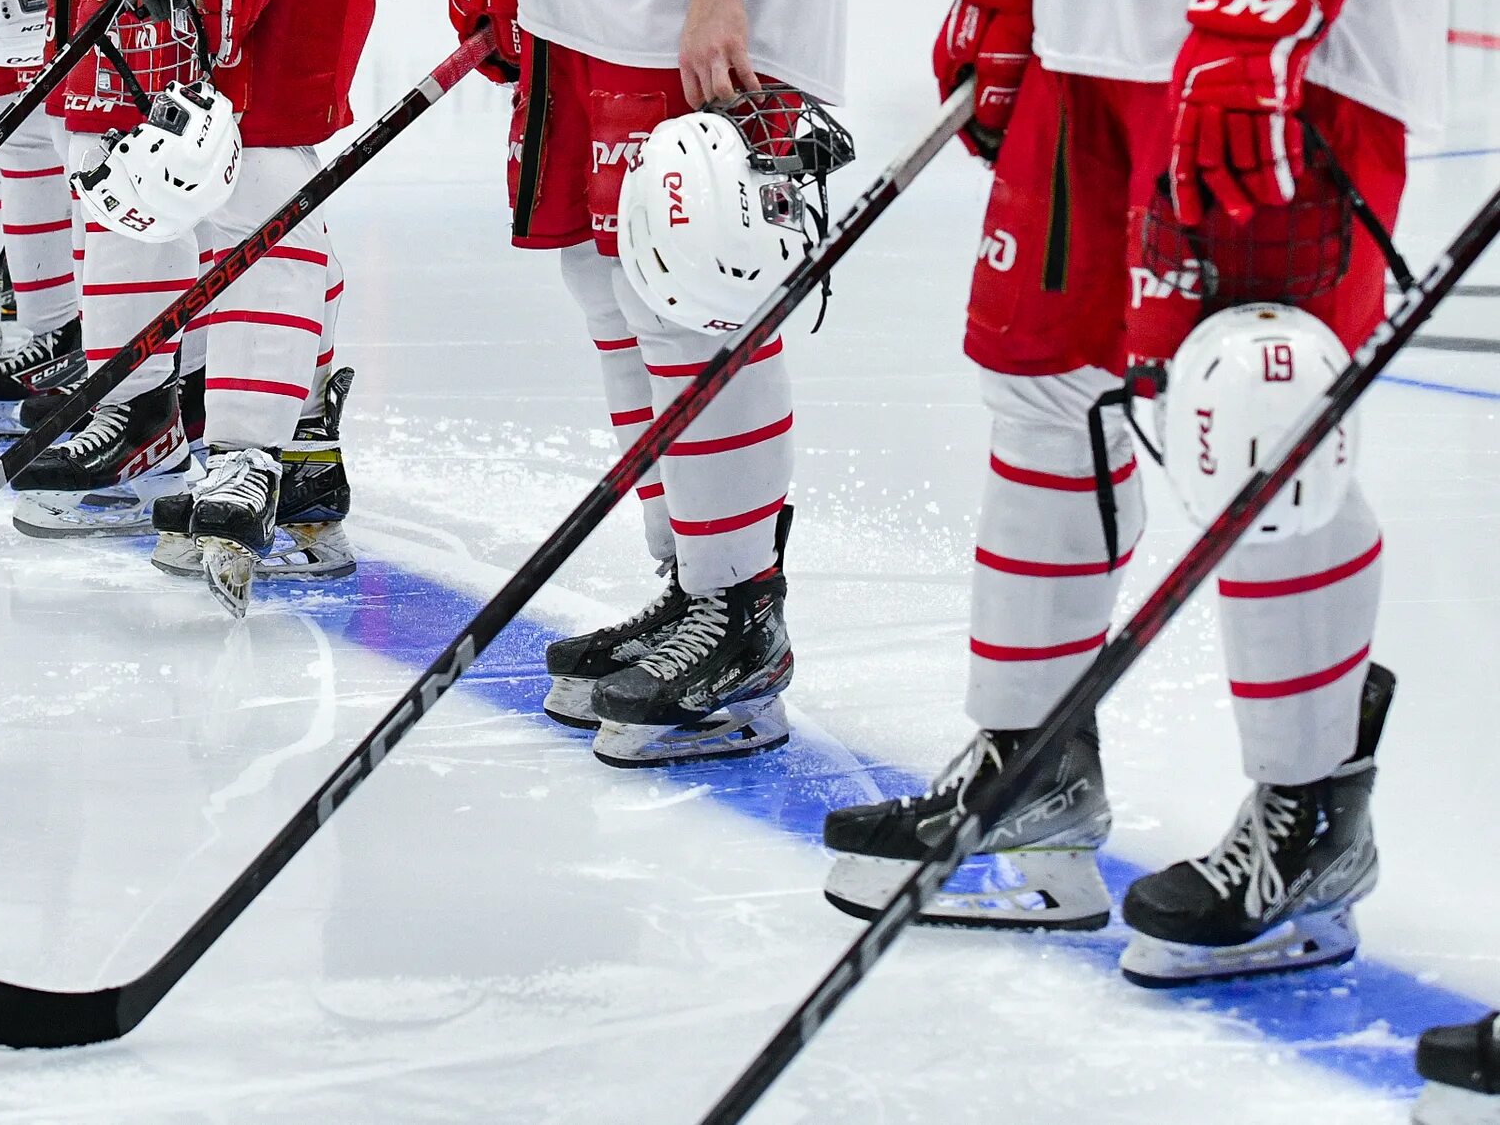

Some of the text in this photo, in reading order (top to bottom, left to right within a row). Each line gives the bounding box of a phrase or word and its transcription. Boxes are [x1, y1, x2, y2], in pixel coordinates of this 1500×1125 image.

[510, 19, 522, 54] CCM
[64, 96, 118, 113] CCM
[737, 180, 750, 229] CCM
[118, 208, 155, 232] 33
[591, 214, 618, 233] CC
[128, 217, 286, 371] JETSPEED
[30, 359, 69, 384] CCM
[116, 421, 186, 483] CCM
[711, 667, 742, 693] BAUER
[316, 633, 476, 827] CCM
